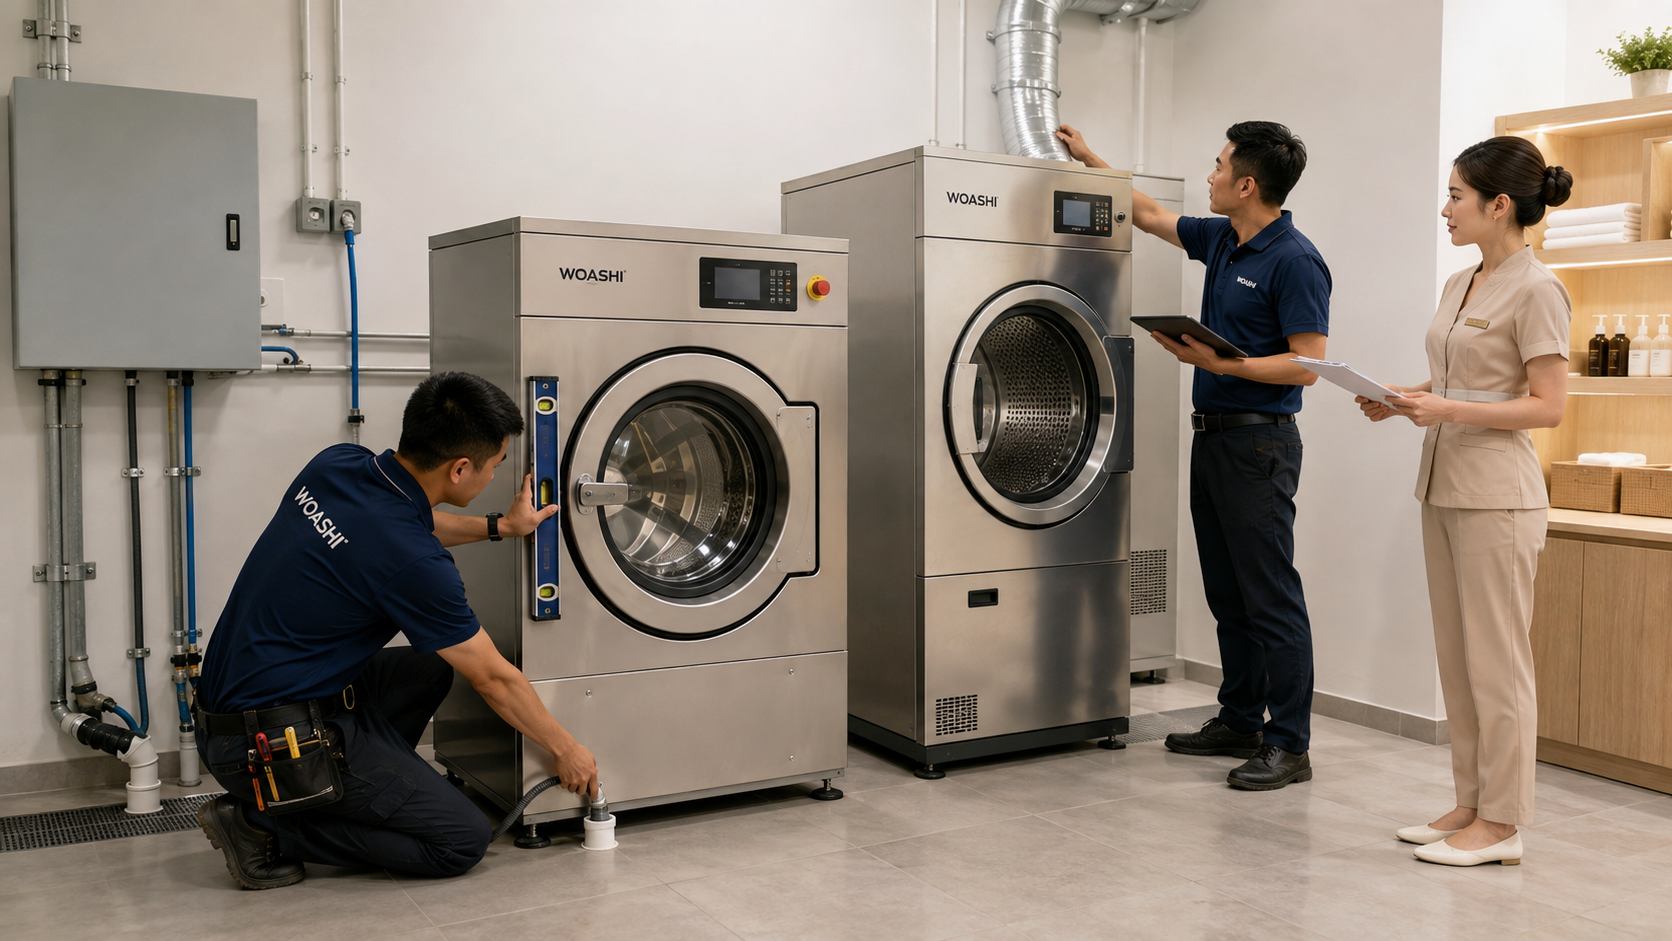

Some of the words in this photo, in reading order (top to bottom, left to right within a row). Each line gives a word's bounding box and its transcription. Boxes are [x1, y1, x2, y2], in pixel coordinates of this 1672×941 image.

[946, 191, 997, 207] WOASHI
[559, 267, 624, 283] WOASHI
[294, 485, 346, 550] WOASHI
